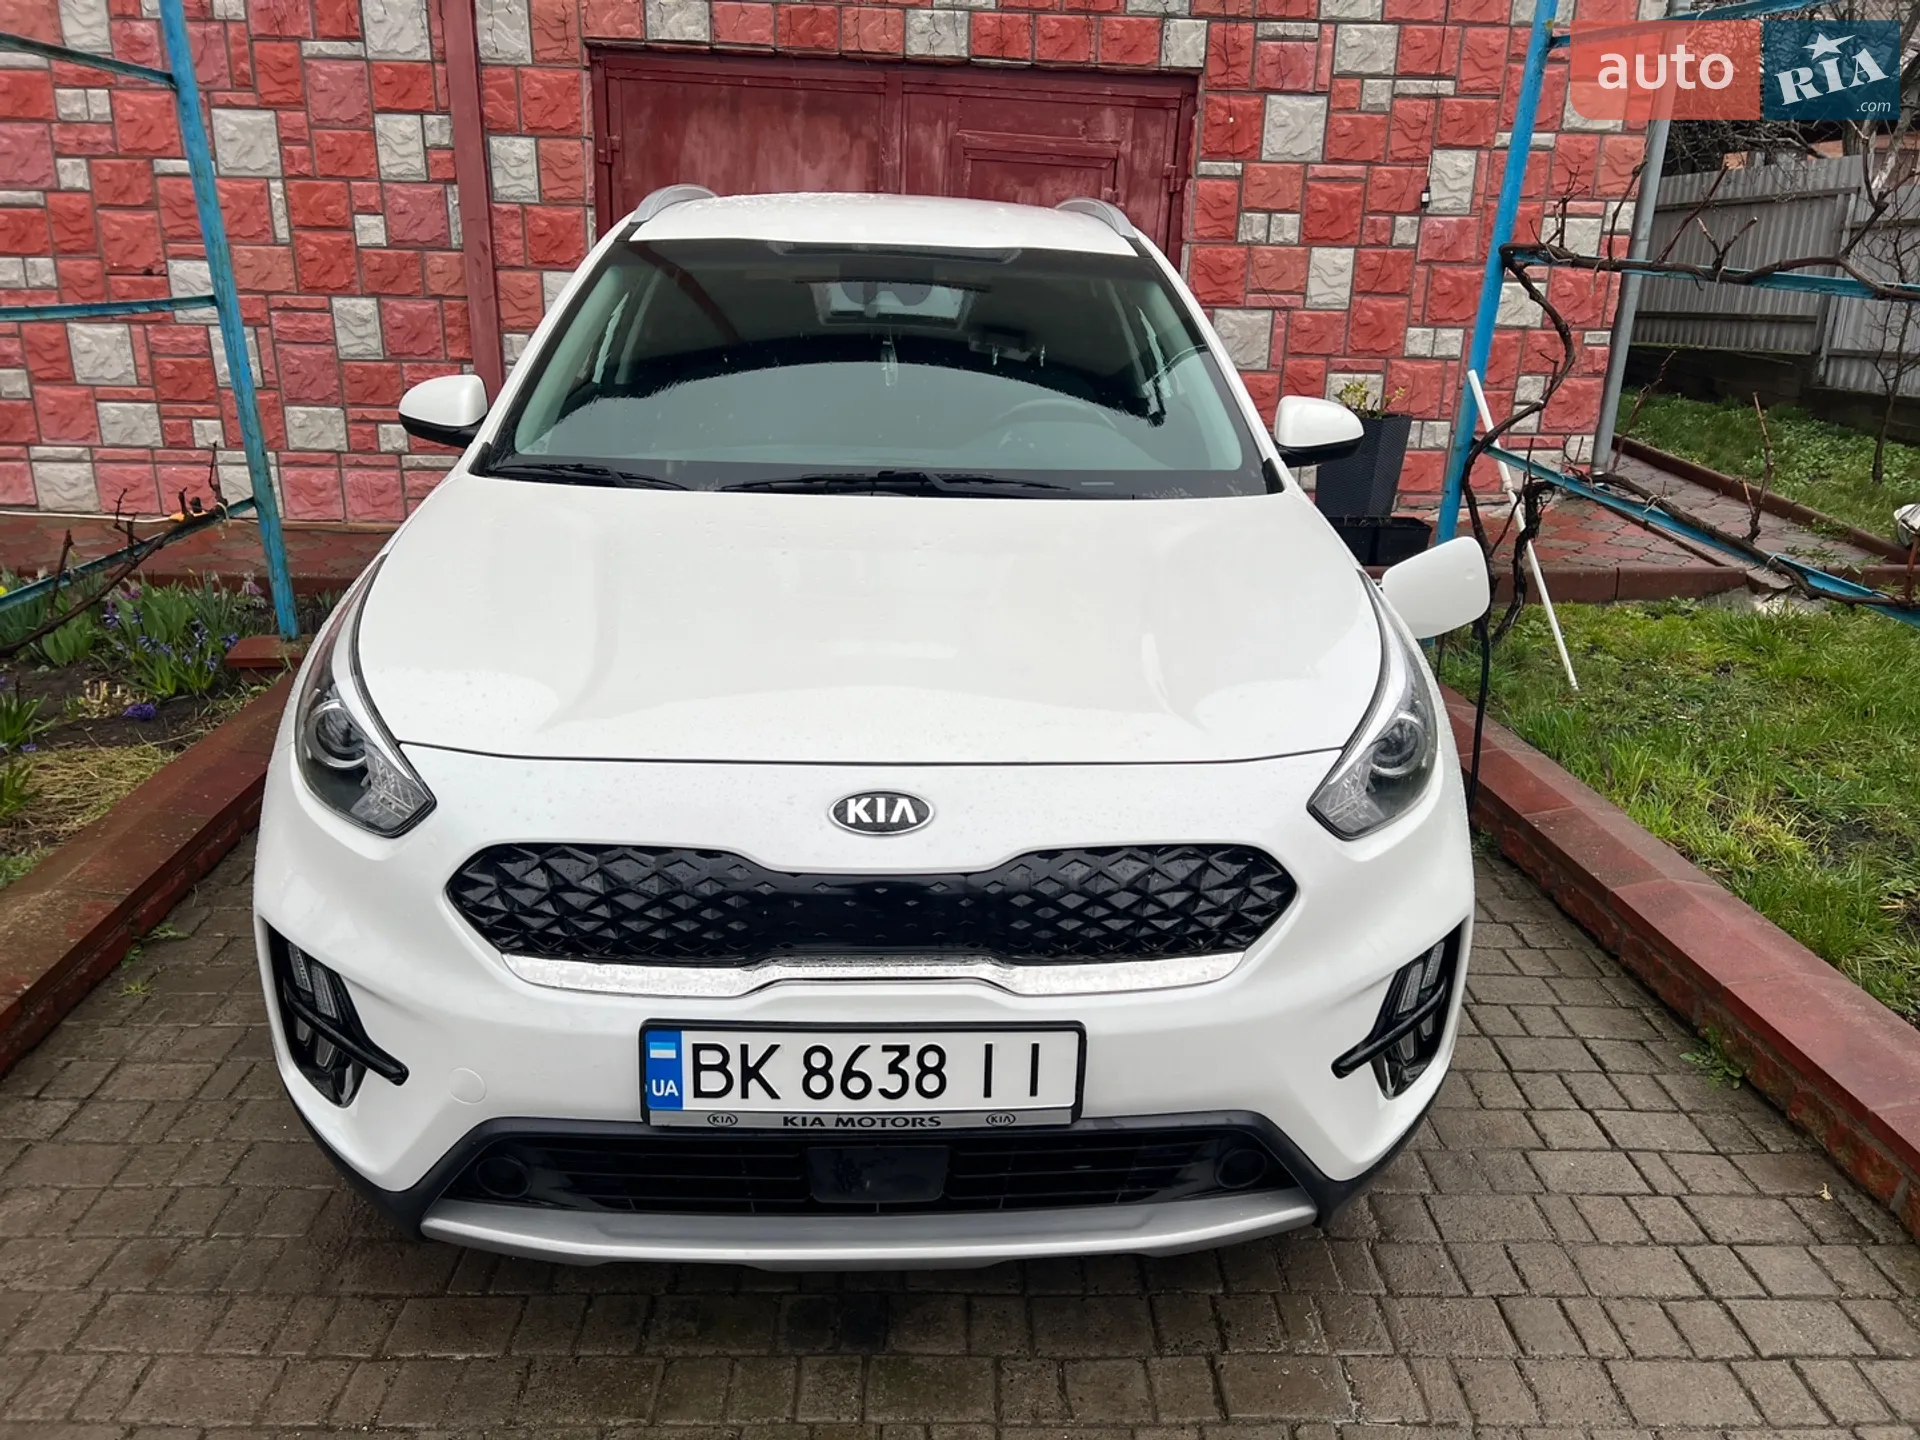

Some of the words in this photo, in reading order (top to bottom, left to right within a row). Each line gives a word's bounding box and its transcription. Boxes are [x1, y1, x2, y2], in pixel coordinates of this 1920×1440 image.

[846, 797, 918, 824] KIA
[691, 1042, 781, 1100] BK
[802, 1043, 947, 1101] 8638
[651, 1079, 679, 1097] UA
[782, 1115, 826, 1128] KIA
[834, 1115, 942, 1128] MOTORS
